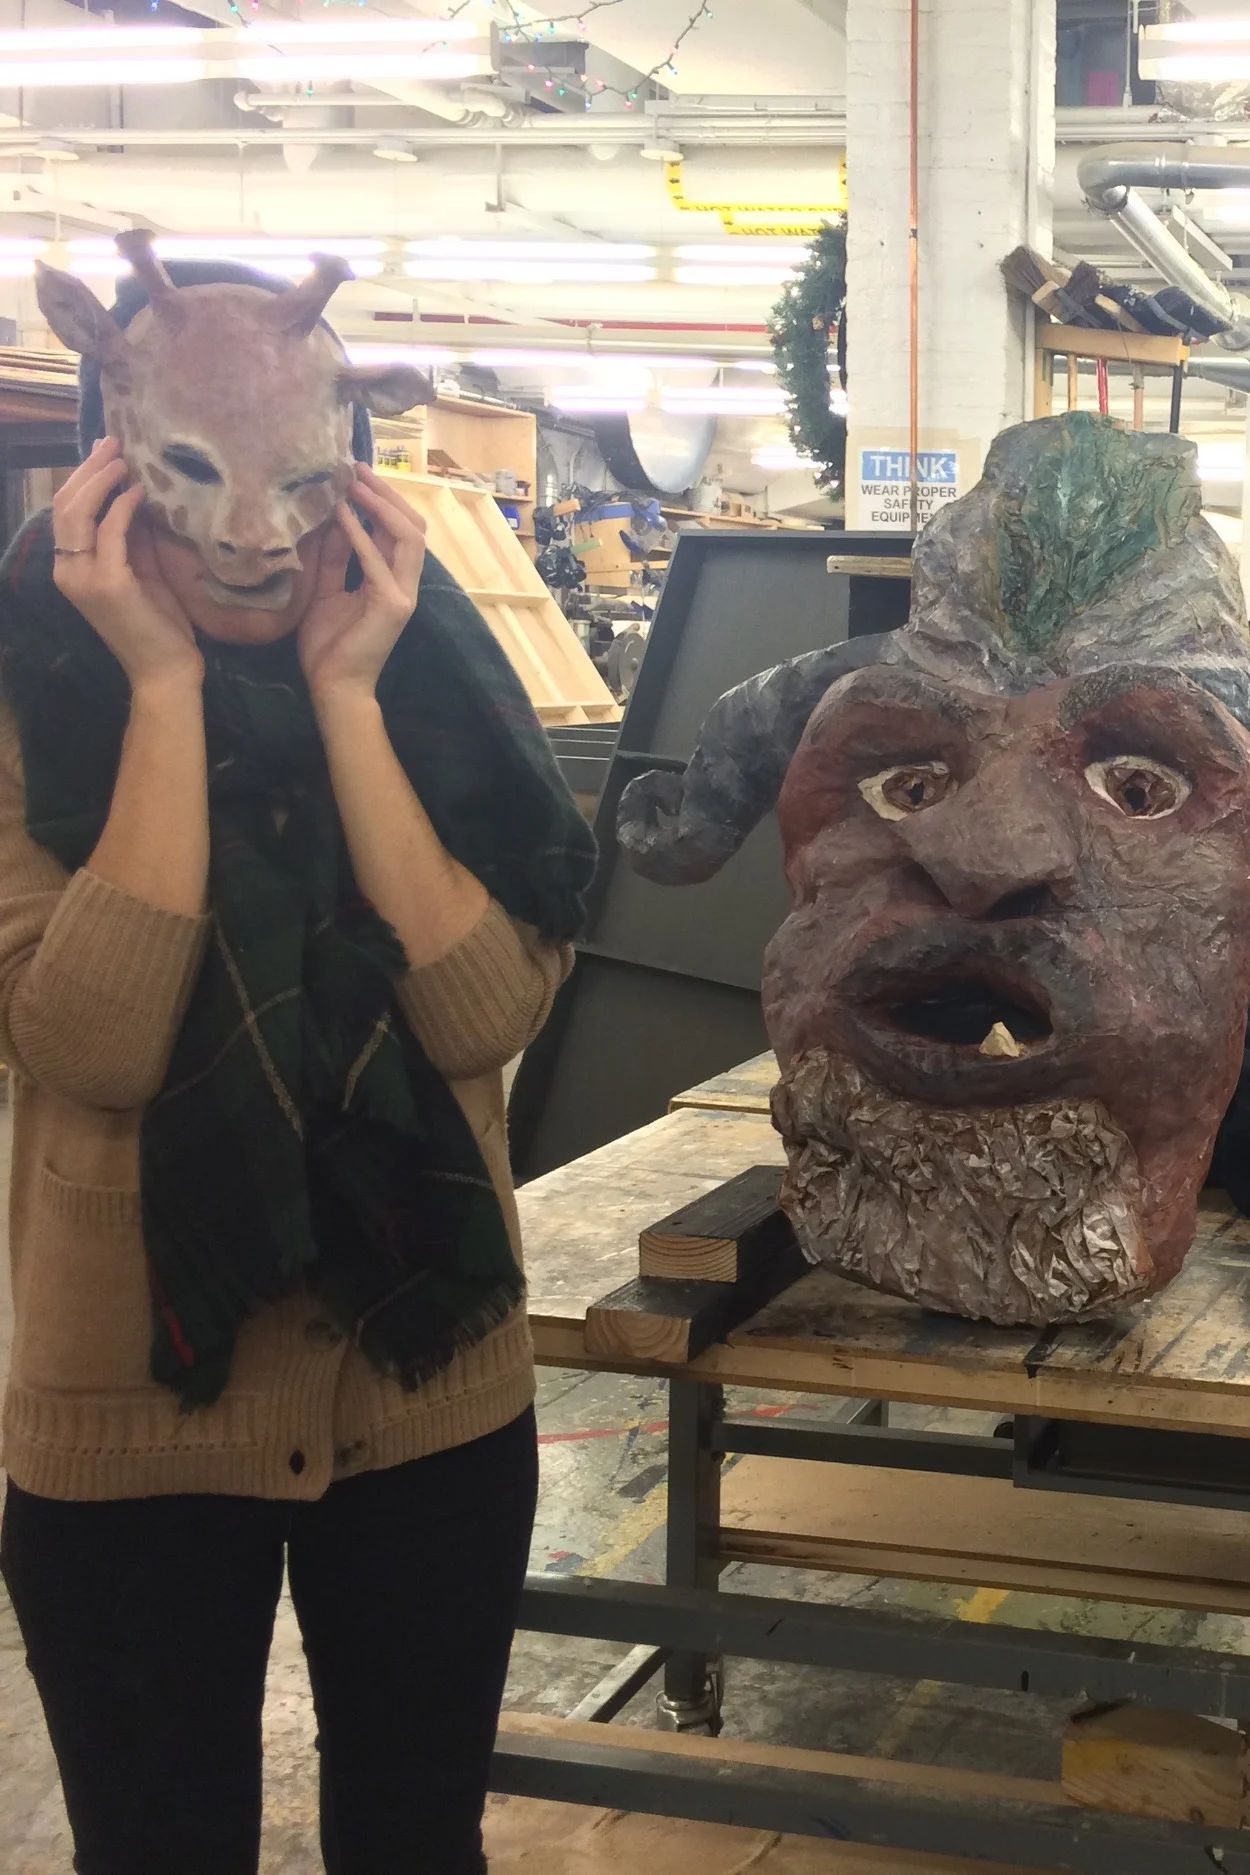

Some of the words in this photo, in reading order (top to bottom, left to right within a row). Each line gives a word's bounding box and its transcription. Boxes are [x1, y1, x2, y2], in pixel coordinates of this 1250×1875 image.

[870, 455, 949, 479] THINK
[861, 485, 899, 496] WEAR
[884, 499, 934, 510] SAFTY
